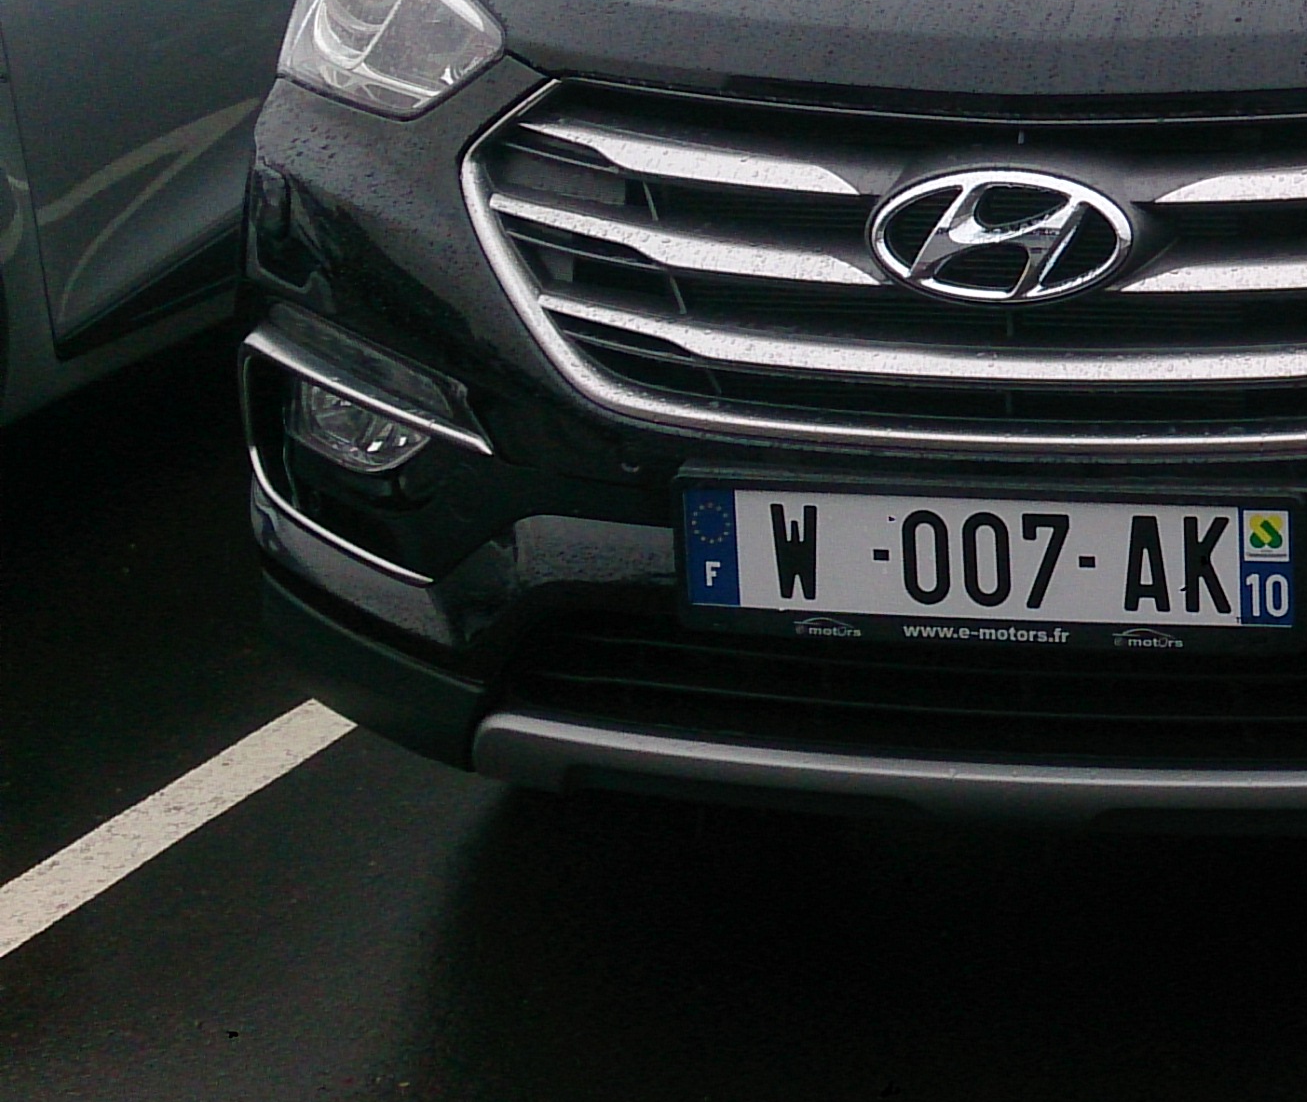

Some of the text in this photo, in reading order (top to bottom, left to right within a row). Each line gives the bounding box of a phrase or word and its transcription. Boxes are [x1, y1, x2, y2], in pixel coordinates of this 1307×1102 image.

[705, 560, 721, 587] F
[1245, 573, 1289, 618] 10
[903, 625, 1070, 643] www.e-motors.fr
